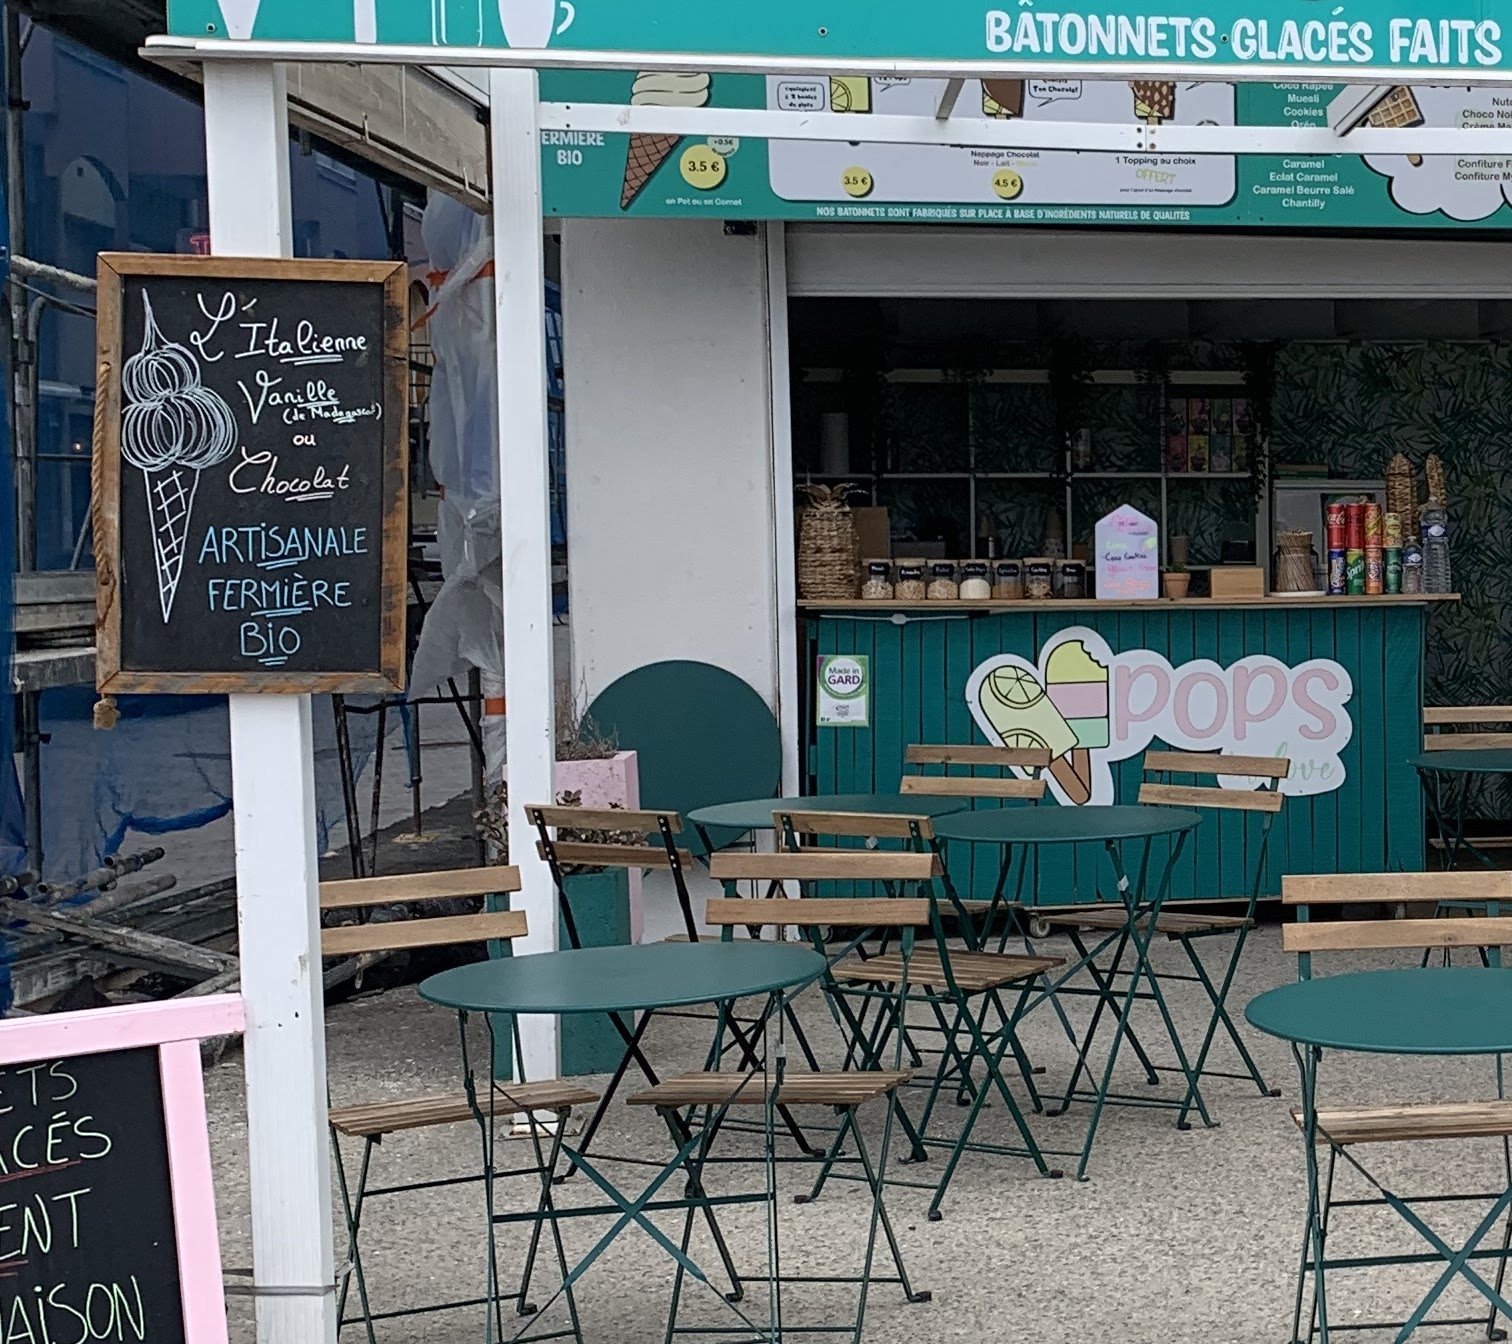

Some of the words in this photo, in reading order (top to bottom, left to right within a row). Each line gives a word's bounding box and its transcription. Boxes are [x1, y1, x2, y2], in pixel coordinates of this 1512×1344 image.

[1231, 7, 1373, 62] GLACÉS
[1389, 18, 1502, 65] FAITS
[1287, 94, 1320, 103] Muesli
[1283, 107, 1323, 116] Cookies
[1462, 109, 1495, 119] Choco
[541, 131, 605, 146] ERMIERE
[556, 150, 583, 165] BIO
[971, 150, 1005, 159] Nappage
[1115, 156, 1120, 164] 1
[1122, 157, 1158, 166] Topping
[1172, 157, 1196, 165] choix
[1282, 159, 1325, 168] Caramel
[1457, 159, 1503, 168] Confiture
[688, 161, 707, 172] 3.5
[711, 161, 719, 172] €
[844, 176, 858, 185] 3.5
[861, 177, 868, 185] €
[1135, 167, 1176, 185] OFFERT
[1269, 172, 1294, 181] Eclat
[1295, 172, 1338, 181] Caramel
[1454, 172, 1500, 181] Confiture
[994, 179, 1008, 187] 4.5
[1010, 179, 1018, 187] €
[1252, 185, 1294, 194] Caramel
[1296, 185, 1331, 195] Beurre
[1332, 185, 1354, 195] Salé
[677, 197, 691, 205] Pot
[714, 198, 742, 206] Cornet
[1282, 198, 1325, 209] Chantilly
[816, 206, 835, 216] NOS
[837, 207, 885, 217] BATONNETS
[887, 207, 910, 217] SONT
[912, 205, 957, 218] FABRIQUÉS
[959, 209, 976, 218] SUR
[977, 209, 1003, 218] PLACE
[1004, 207, 1012, 219] À
[1013, 209, 1035, 219] BASE
[1037, 208, 1096, 219] D'INGRÉDIENTS
[1098, 210, 1138, 220] NATURELS
[1140, 210, 1150, 220] DE
[1152, 209, 1190, 221] QUALITÉS
[190, 291, 368, 362] L'Italienne
[237, 371, 340, 425] Vanille
[293, 433, 316, 447] ou
[229, 446, 350, 494] Chocolat
[852, 666, 860, 674] in
[827, 675, 860, 685] GARD
